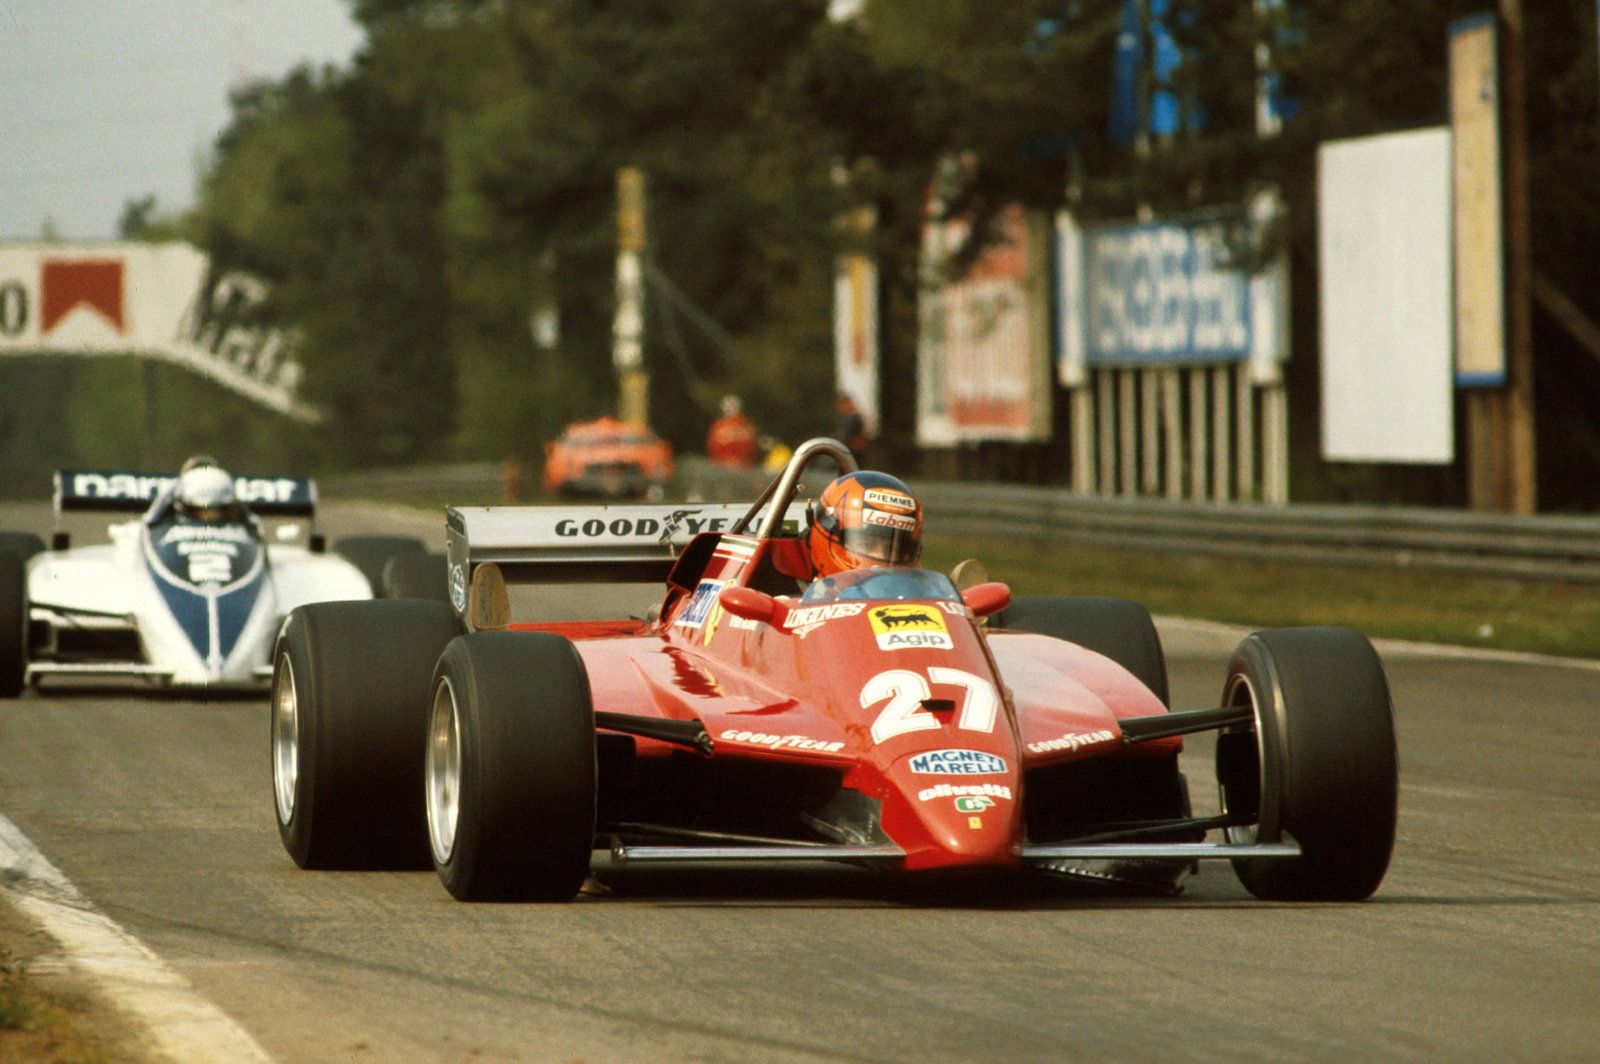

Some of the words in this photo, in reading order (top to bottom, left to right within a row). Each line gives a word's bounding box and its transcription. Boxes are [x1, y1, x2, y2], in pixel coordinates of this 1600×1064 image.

[868, 492, 913, 508] PIEMME
[782, 603, 868, 628] LONGINES
[887, 632, 945, 647] Agip
[859, 667, 998, 745] 27
[918, 784, 1012, 801] olivetti
